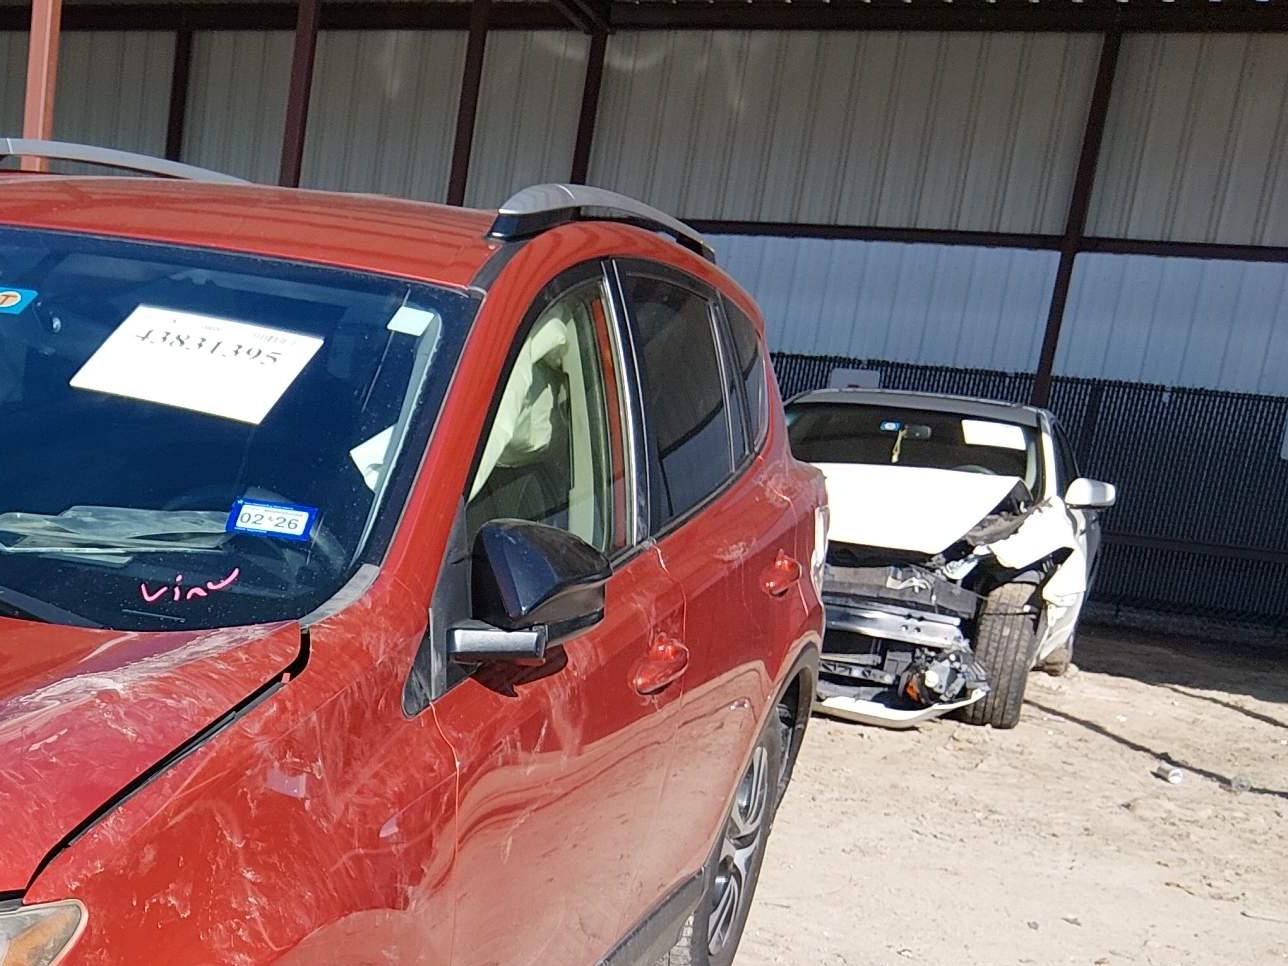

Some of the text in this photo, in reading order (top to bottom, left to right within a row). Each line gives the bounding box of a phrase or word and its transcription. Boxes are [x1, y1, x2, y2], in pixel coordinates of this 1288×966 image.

[135, 328, 283, 365] 43831395
[239, 511, 265, 526] 02
[274, 515, 300, 530] 26
